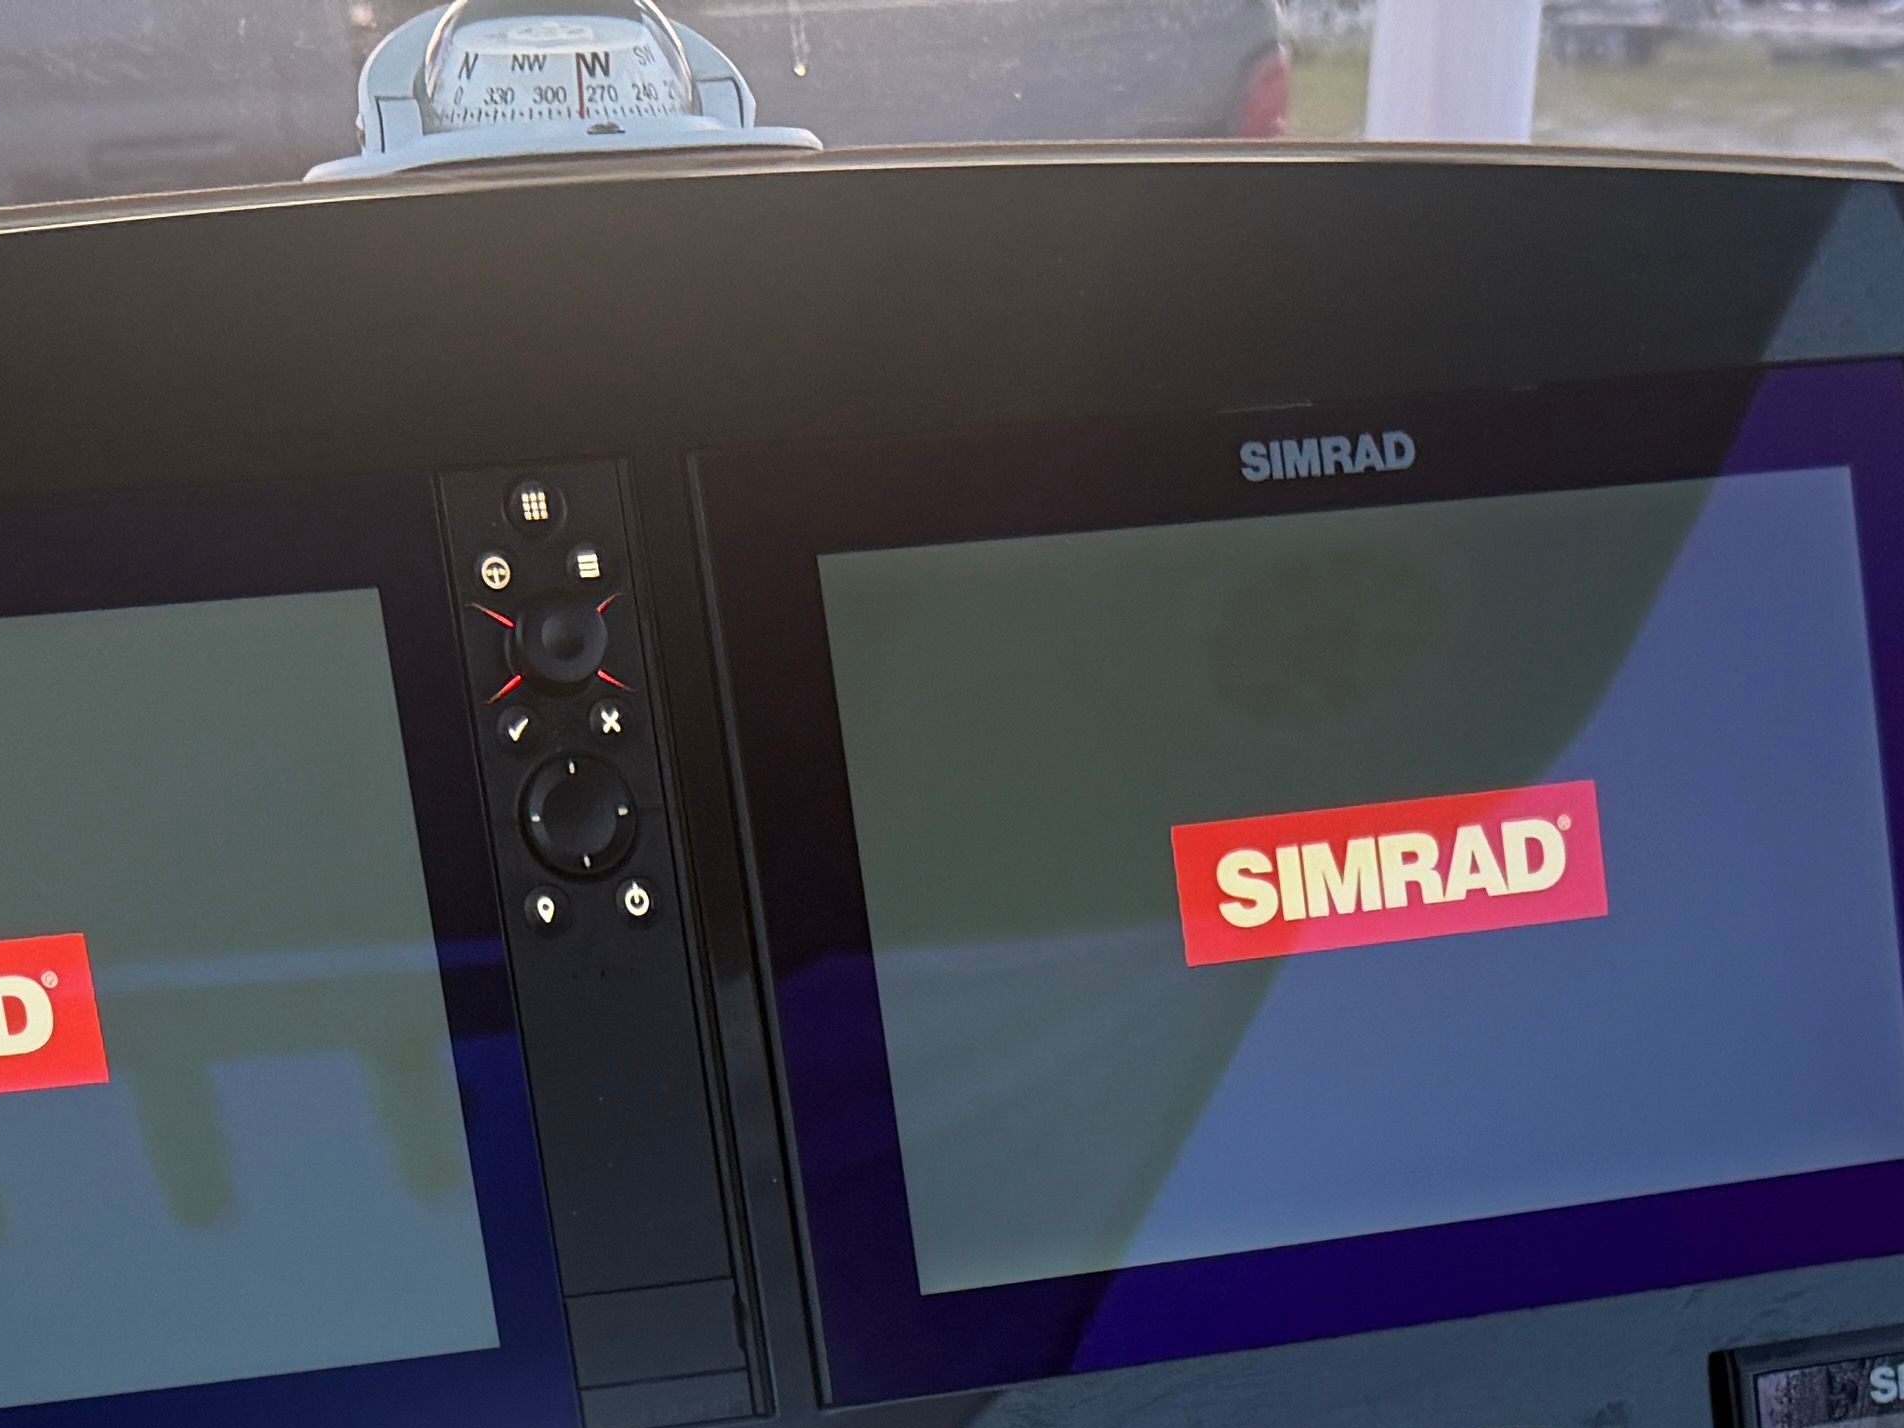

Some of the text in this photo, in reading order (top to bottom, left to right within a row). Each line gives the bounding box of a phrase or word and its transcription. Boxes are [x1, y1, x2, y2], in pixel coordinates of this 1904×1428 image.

[458, 52, 479, 79] N
[510, 54, 546, 72] NW
[533, 86, 567, 104] 300
[587, 85, 618, 102] 270
[1241, 429, 1416, 483] SIMRAD
